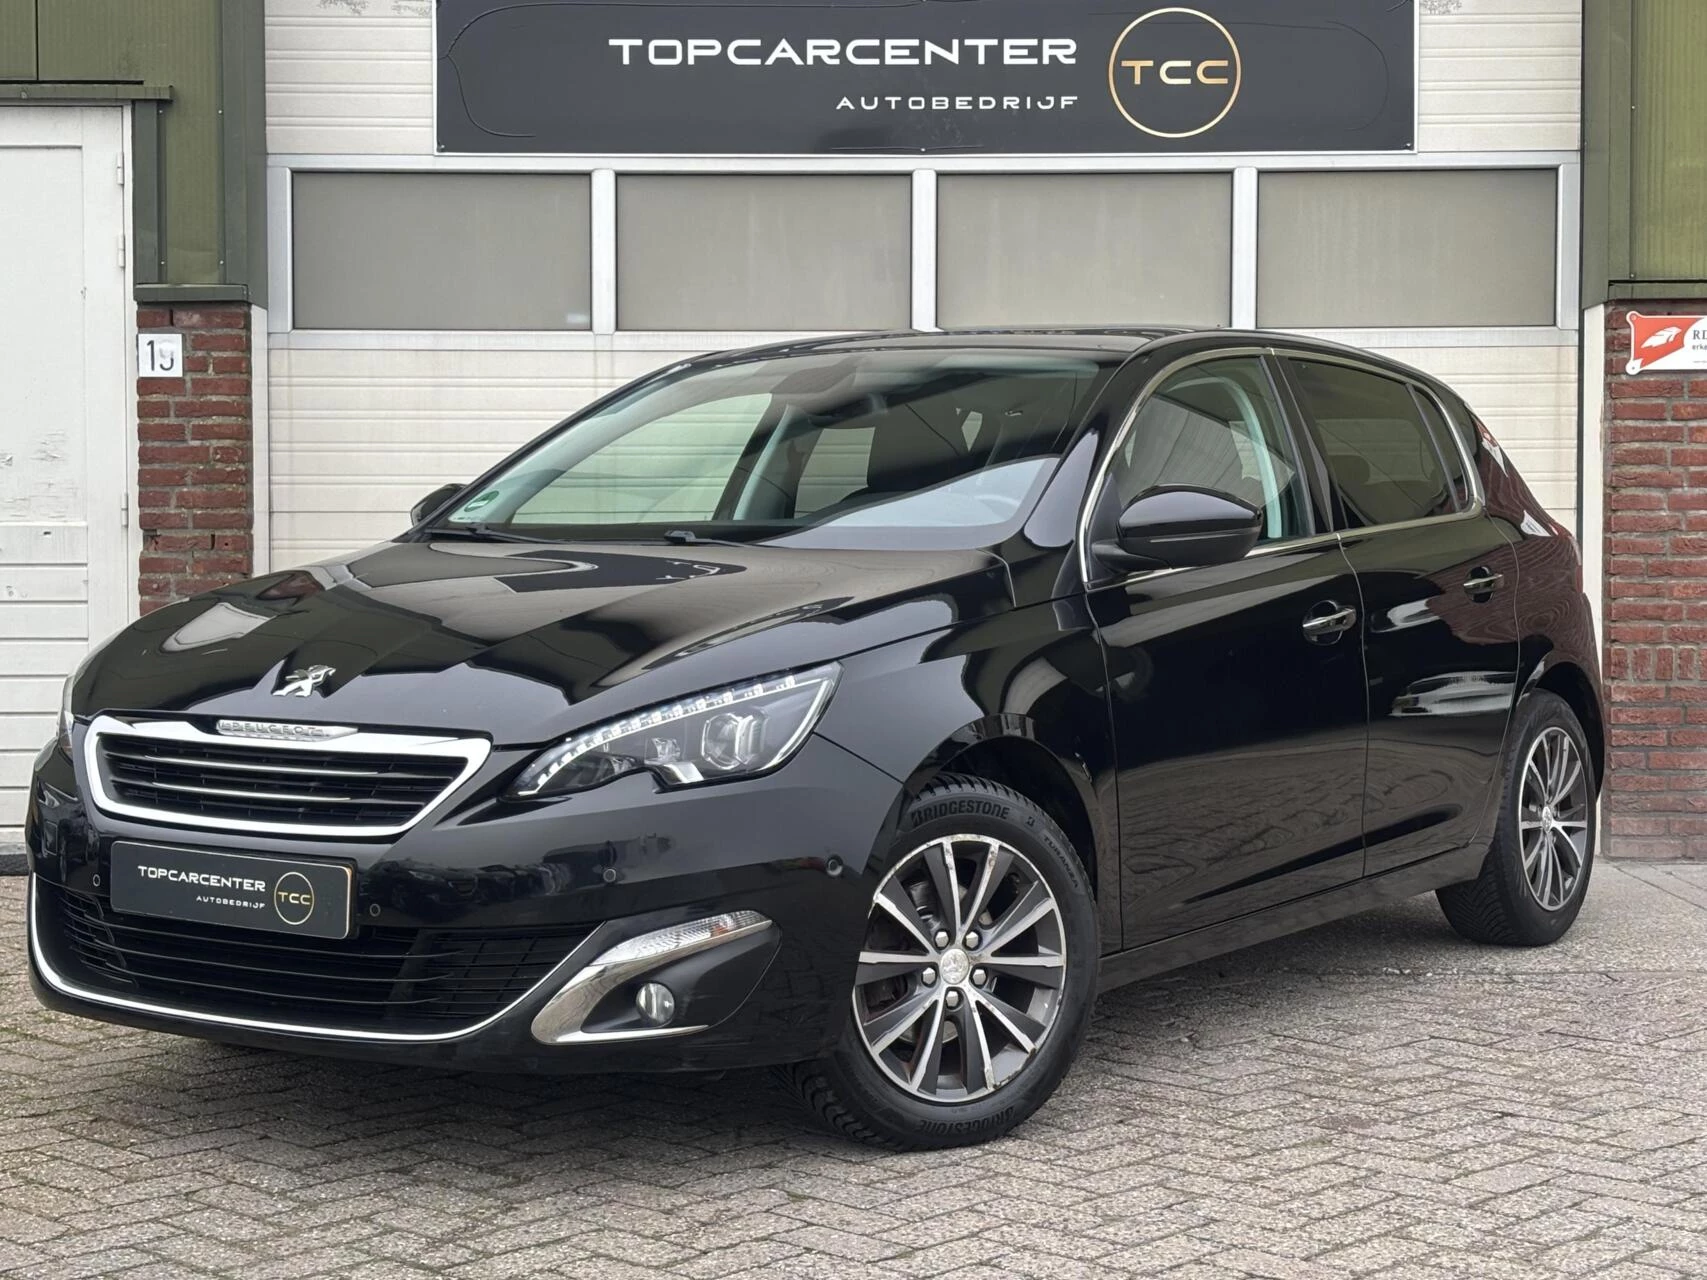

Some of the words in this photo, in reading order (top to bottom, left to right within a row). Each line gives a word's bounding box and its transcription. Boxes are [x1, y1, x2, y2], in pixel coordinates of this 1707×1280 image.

[608, 37, 1078, 67] TOPCARCENTER
[1121, 60, 1229, 85] TCC
[836, 95, 1078, 111] AUTOBEDRIJF
[910, 799, 1010, 828] BRIDGESTONE
[137, 865, 266, 892] TOPCARCENTER
[195, 894, 266, 910] AUTOBEDRIJF
[277, 891, 311, 905] TCC
